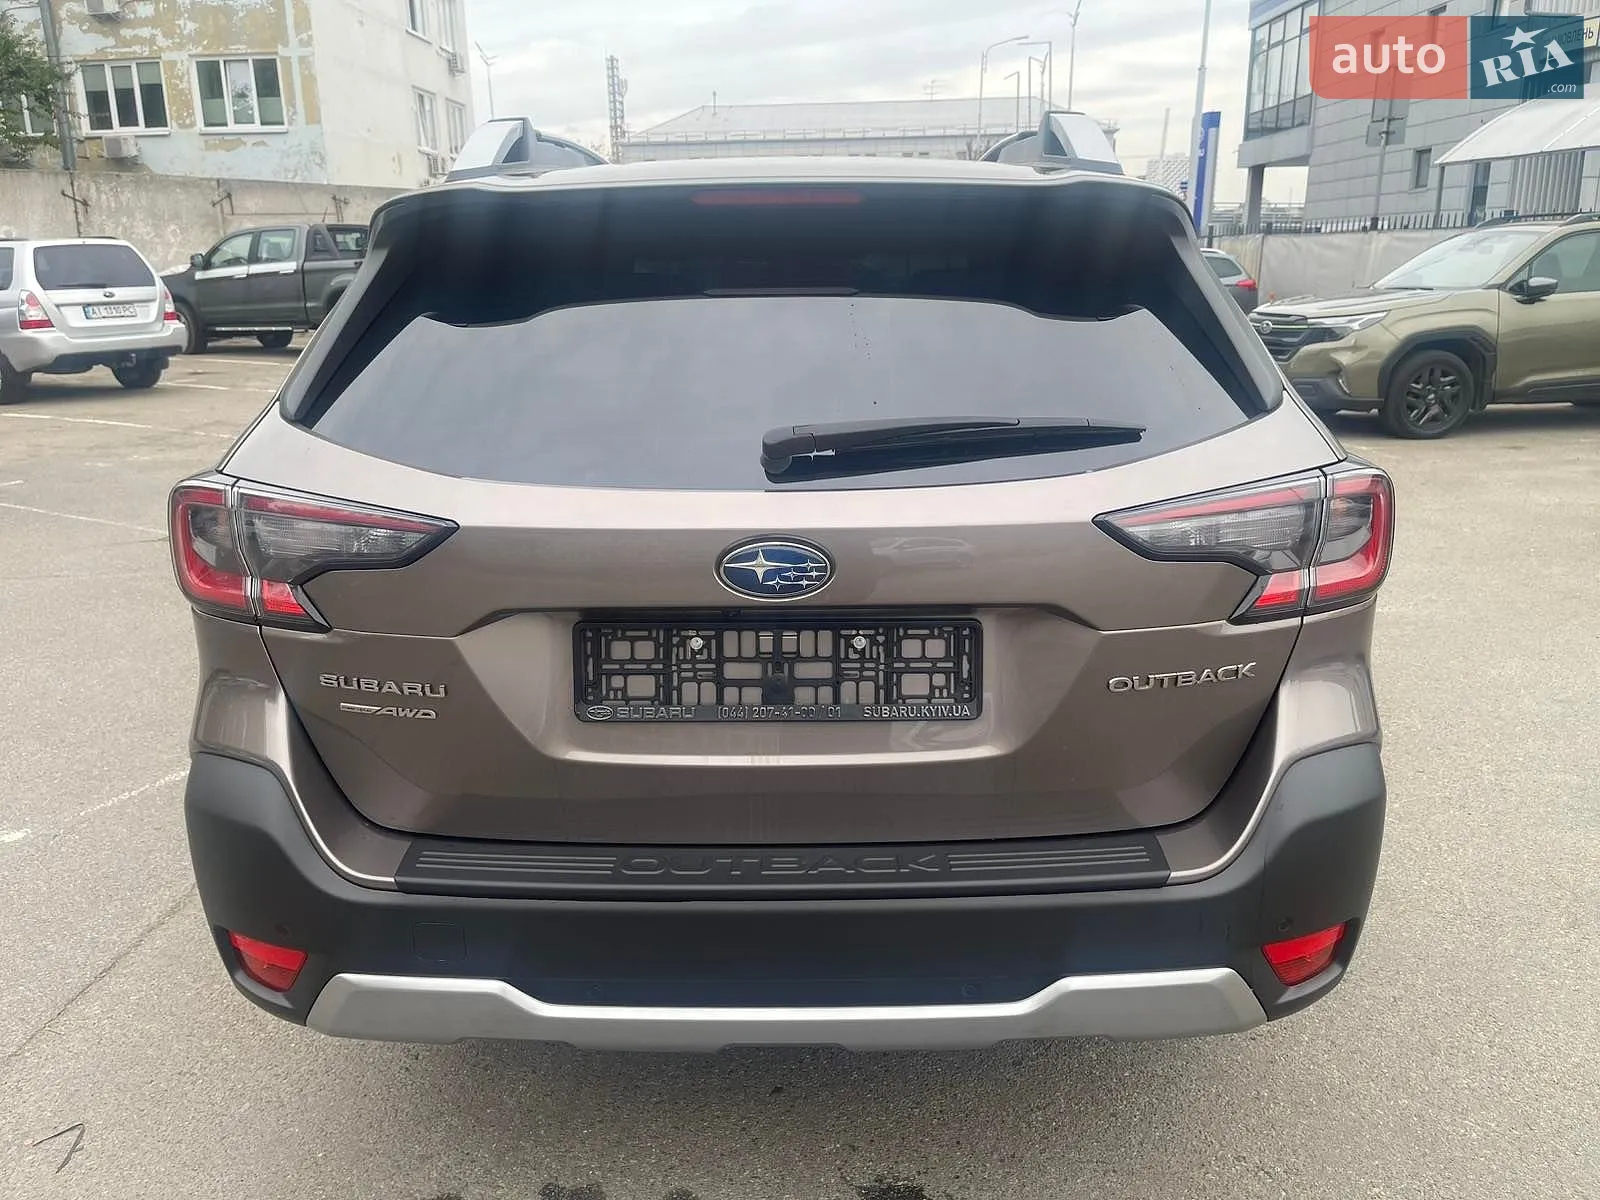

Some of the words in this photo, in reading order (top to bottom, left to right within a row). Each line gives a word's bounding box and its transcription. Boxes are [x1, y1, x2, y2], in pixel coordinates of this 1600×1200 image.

[319, 673, 446, 698] SUBARU
[1108, 662, 1257, 693] OUTBACK
[375, 706, 437, 719] AWD
[616, 706, 695, 719] SUBARU
[863, 705, 970, 719] SUBARU.KYIV.UA
[620, 854, 941, 875] OUTBACK
